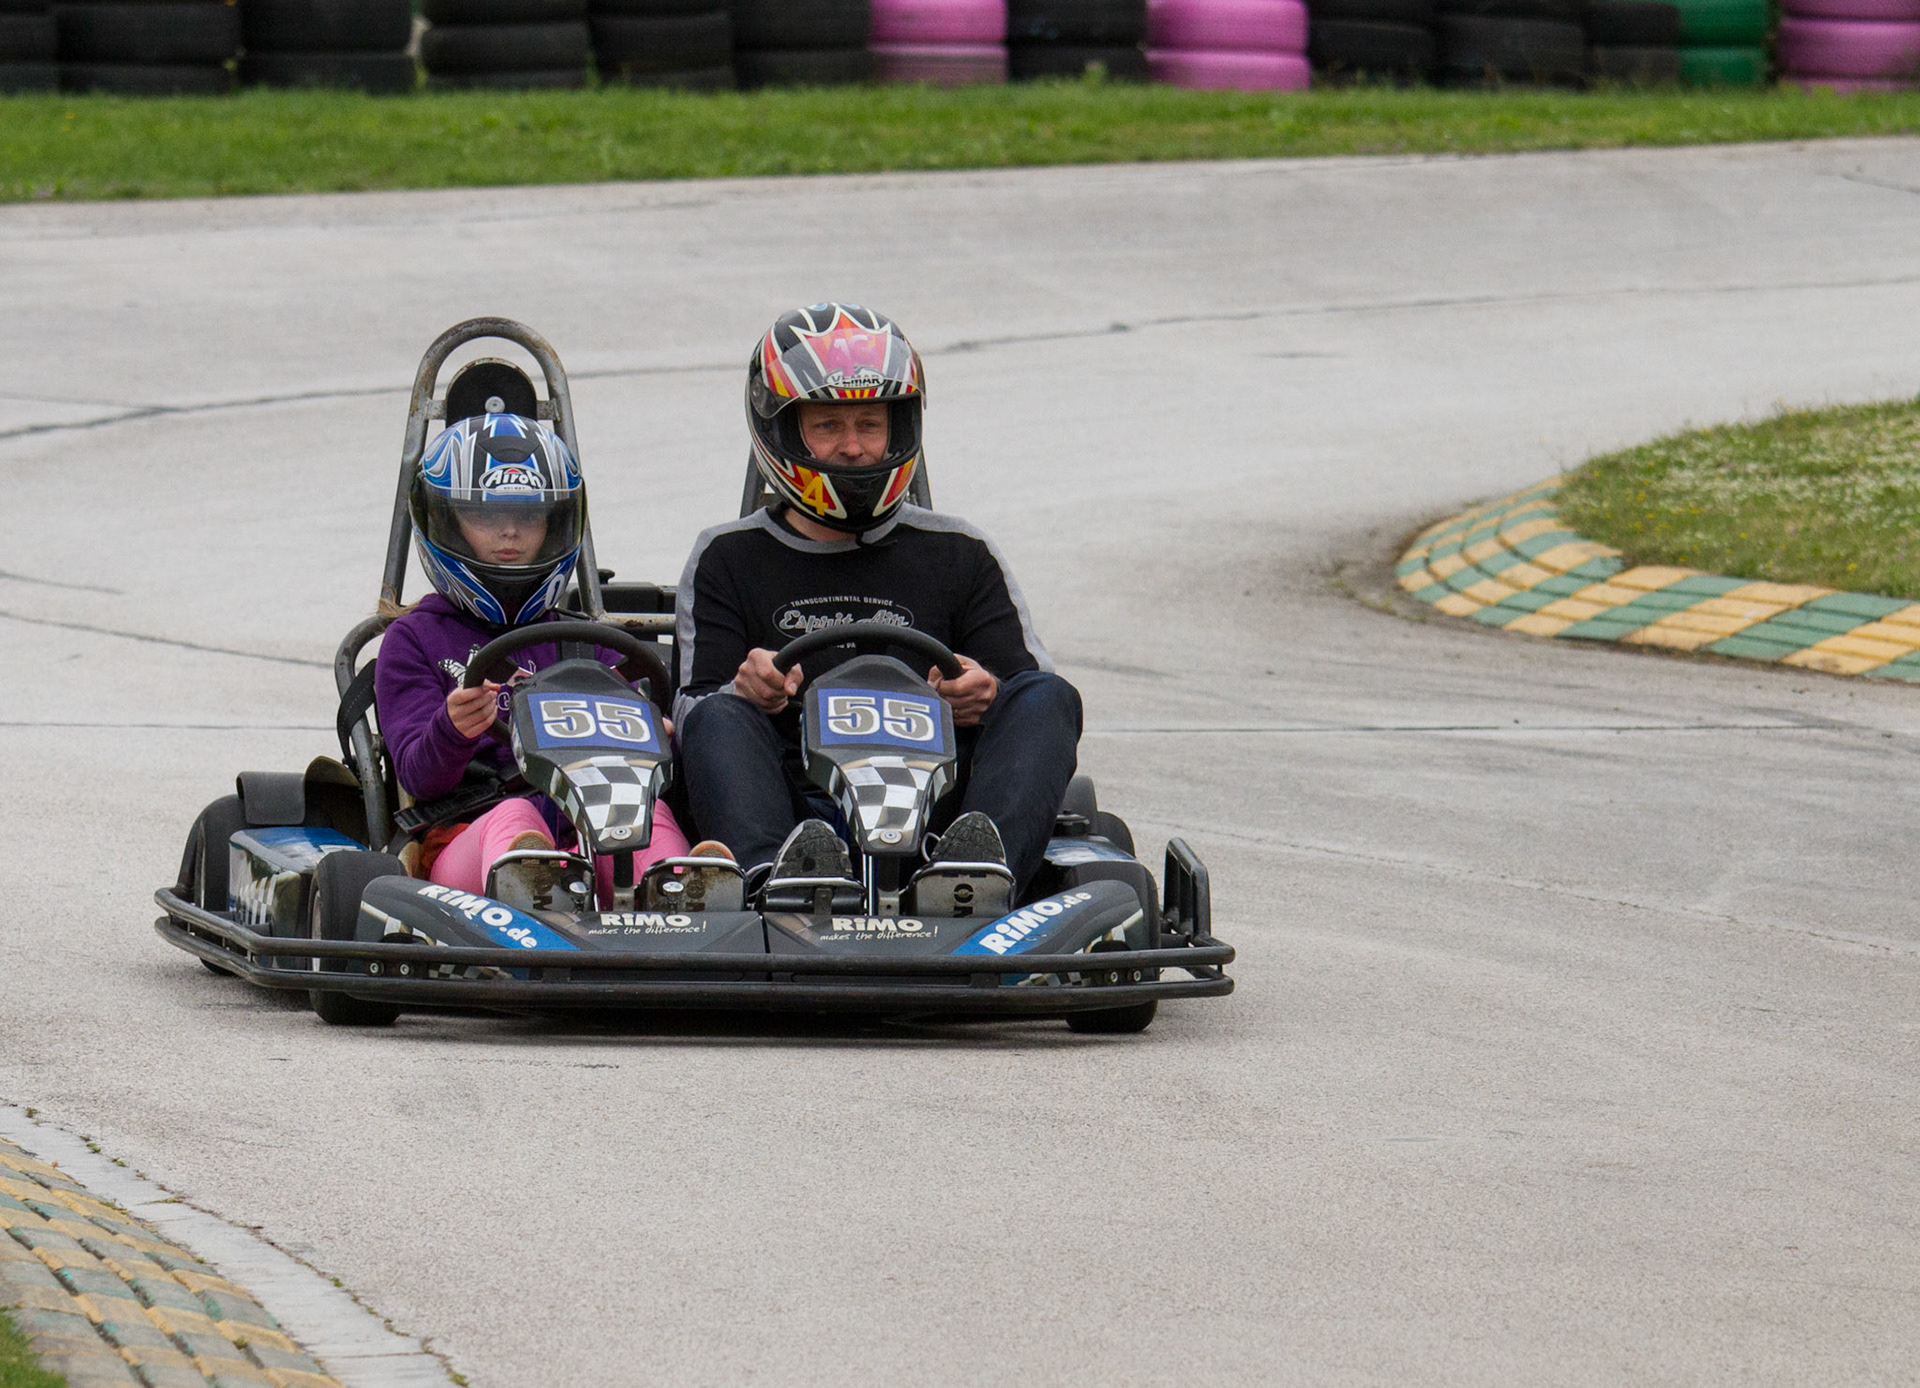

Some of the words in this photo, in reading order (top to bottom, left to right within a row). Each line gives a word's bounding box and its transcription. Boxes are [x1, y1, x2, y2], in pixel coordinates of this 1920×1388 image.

[485, 469, 542, 488] Airoh
[801, 475, 829, 516] 4
[790, 595, 861, 607] TRANSCONTINENTAL
[540, 700, 651, 743] 55
[828, 695, 935, 742] 55
[588, 927, 619, 935] makes
[624, 926, 641, 935] the
[820, 932, 851, 941] makes
[855, 931, 873, 941] the
